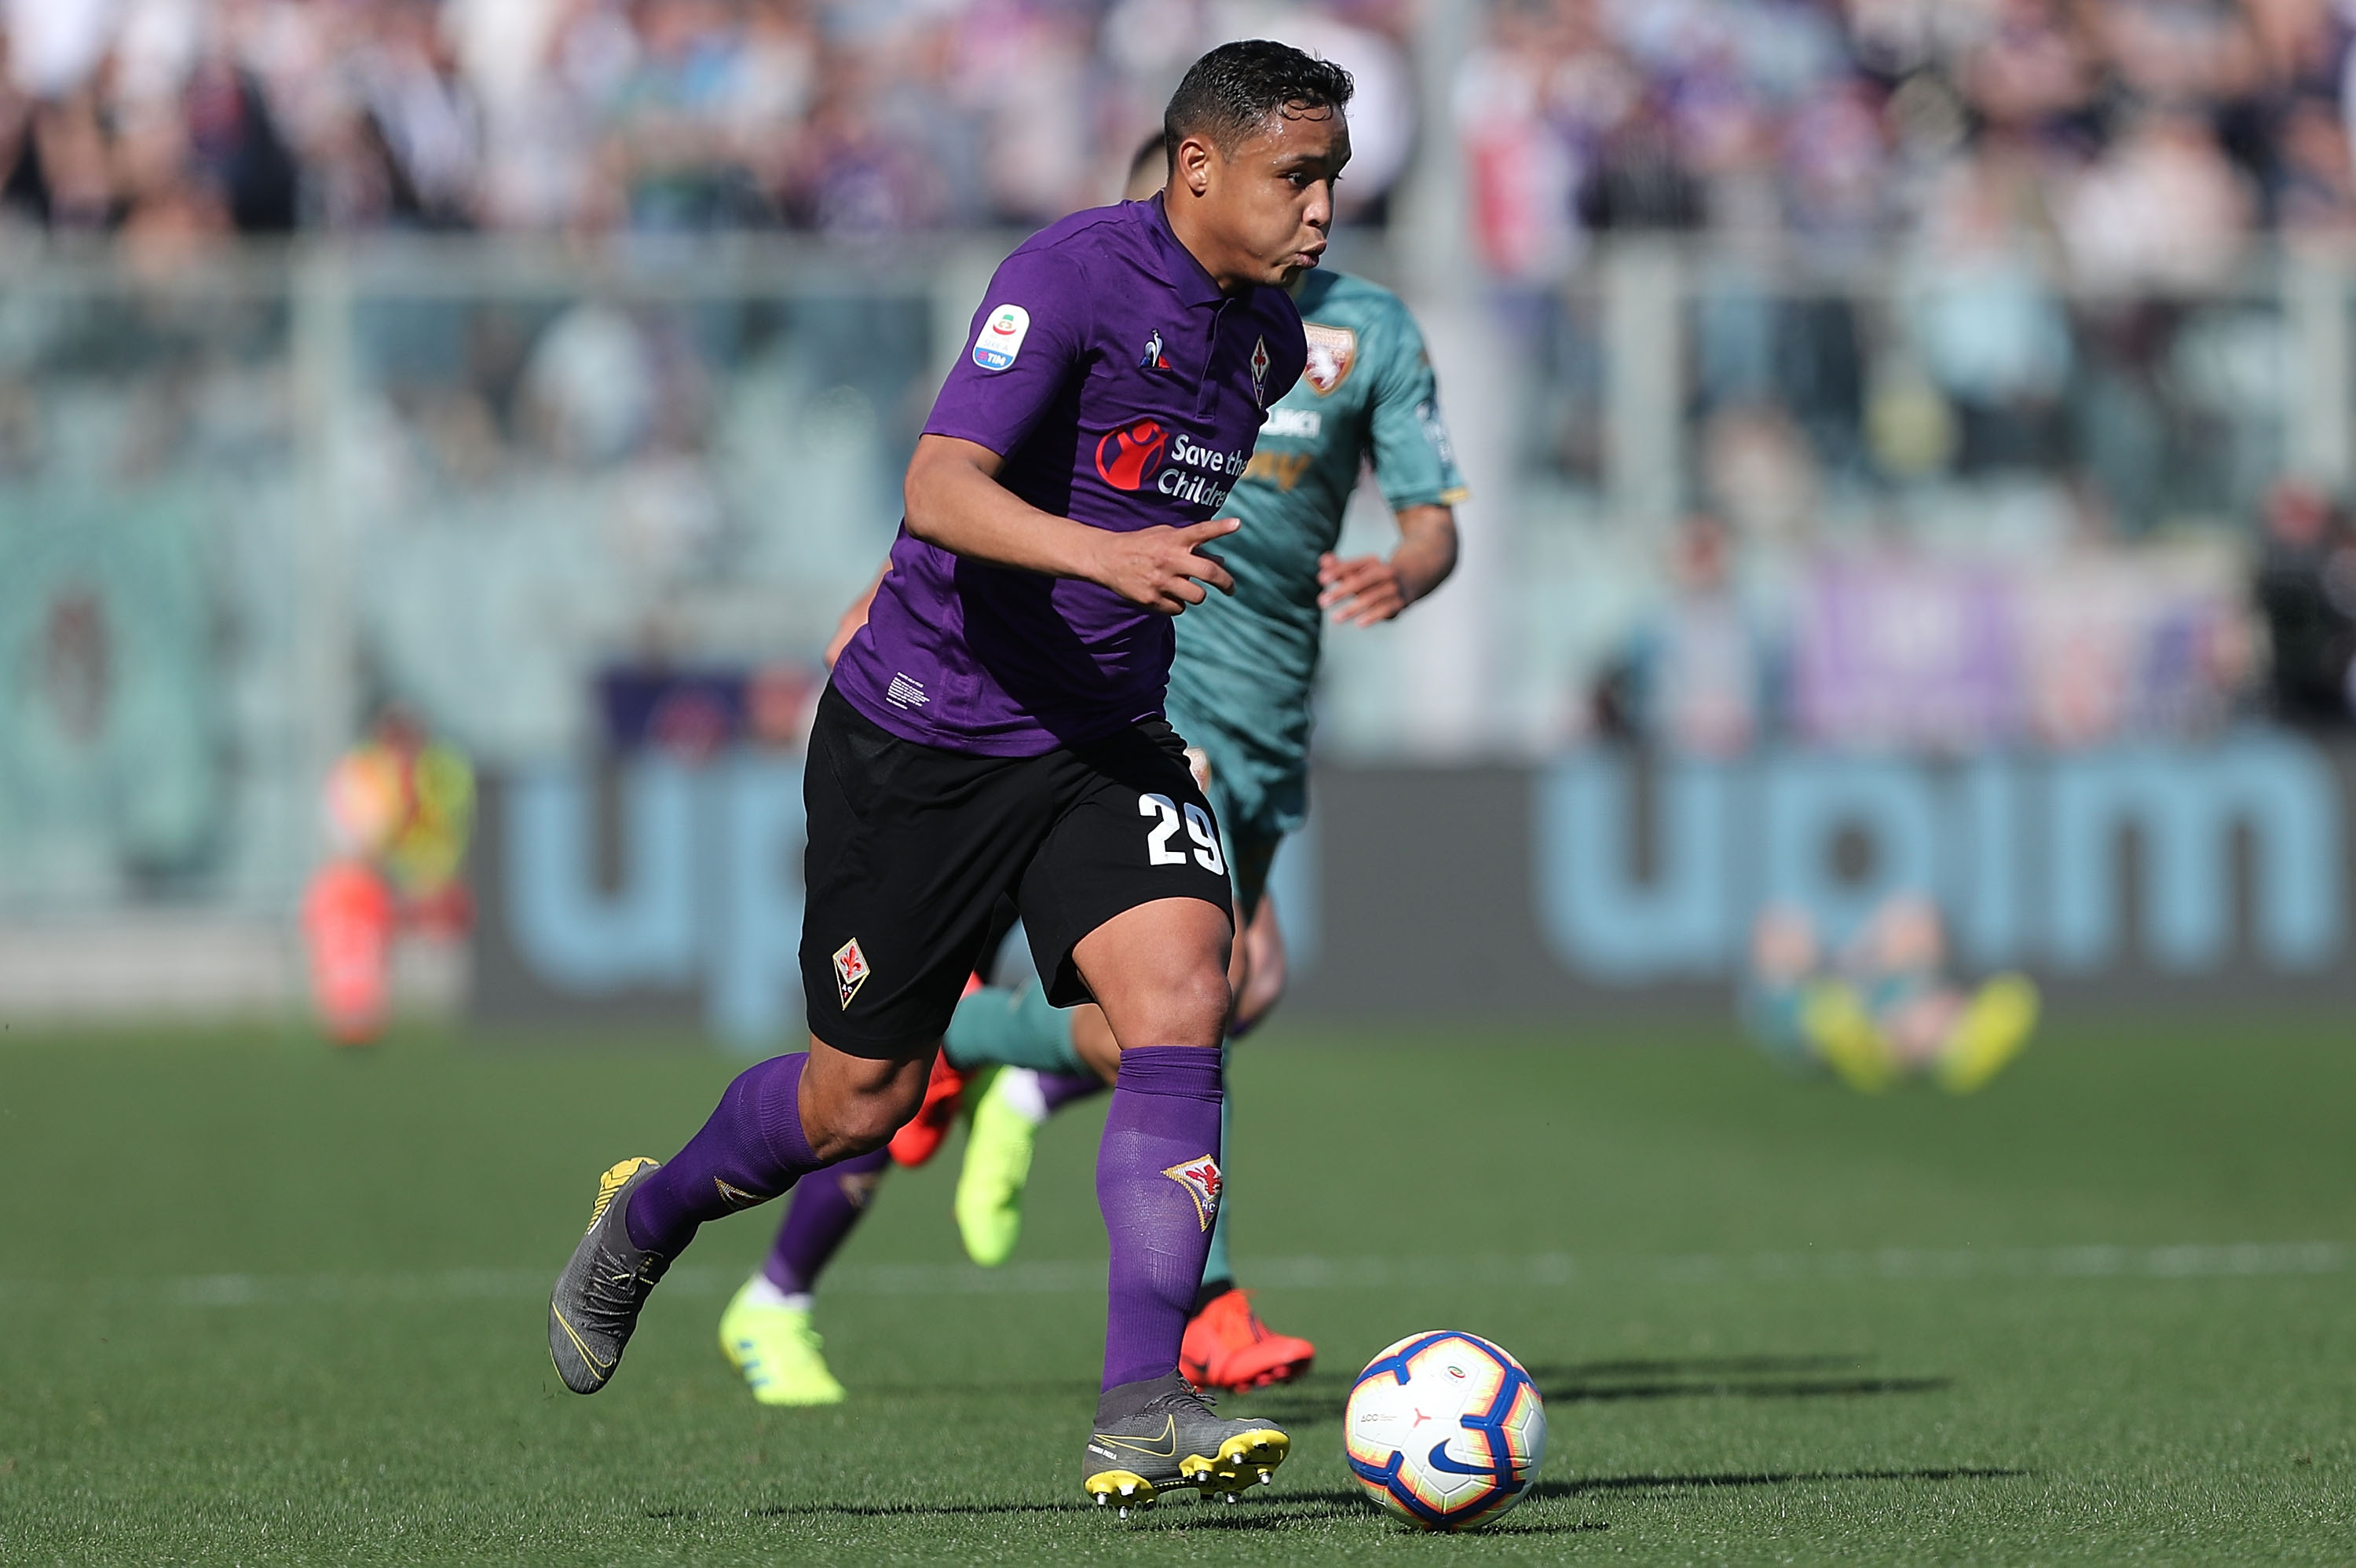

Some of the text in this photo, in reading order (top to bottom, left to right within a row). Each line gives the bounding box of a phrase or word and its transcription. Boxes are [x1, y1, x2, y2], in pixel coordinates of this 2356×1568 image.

[987, 353, 1006, 366] TIM
[1171, 434, 1224, 471] Save
[1158, 469, 1228, 508] Childre
[1139, 793, 1224, 875] 29
[1535, 730, 2344, 985] upim
